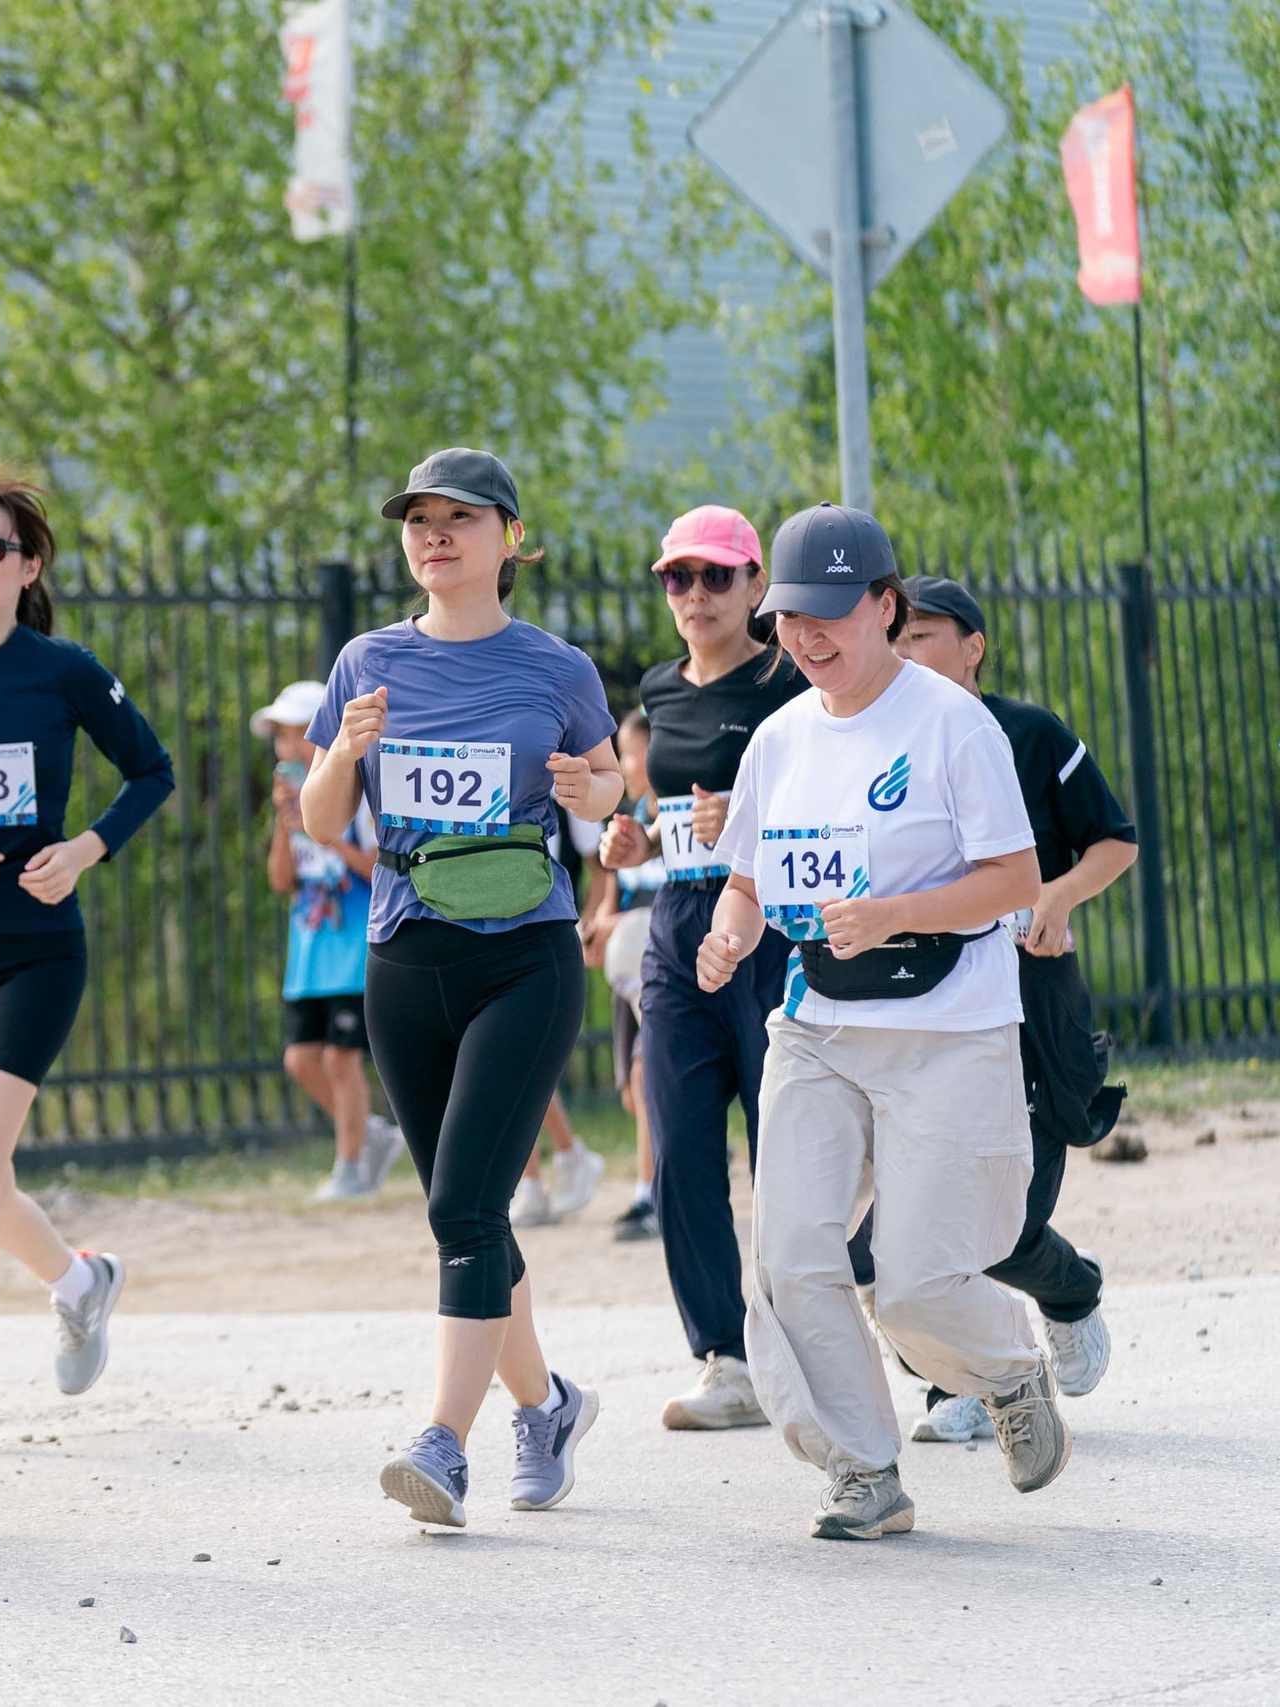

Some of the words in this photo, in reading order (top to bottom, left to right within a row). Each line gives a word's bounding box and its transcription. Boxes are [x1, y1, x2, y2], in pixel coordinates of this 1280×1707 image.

[825, 565, 854, 573] JOGEL
[406, 767, 482, 807] 192
[671, 822, 716, 854] 17
[781, 850, 846, 889] 134
